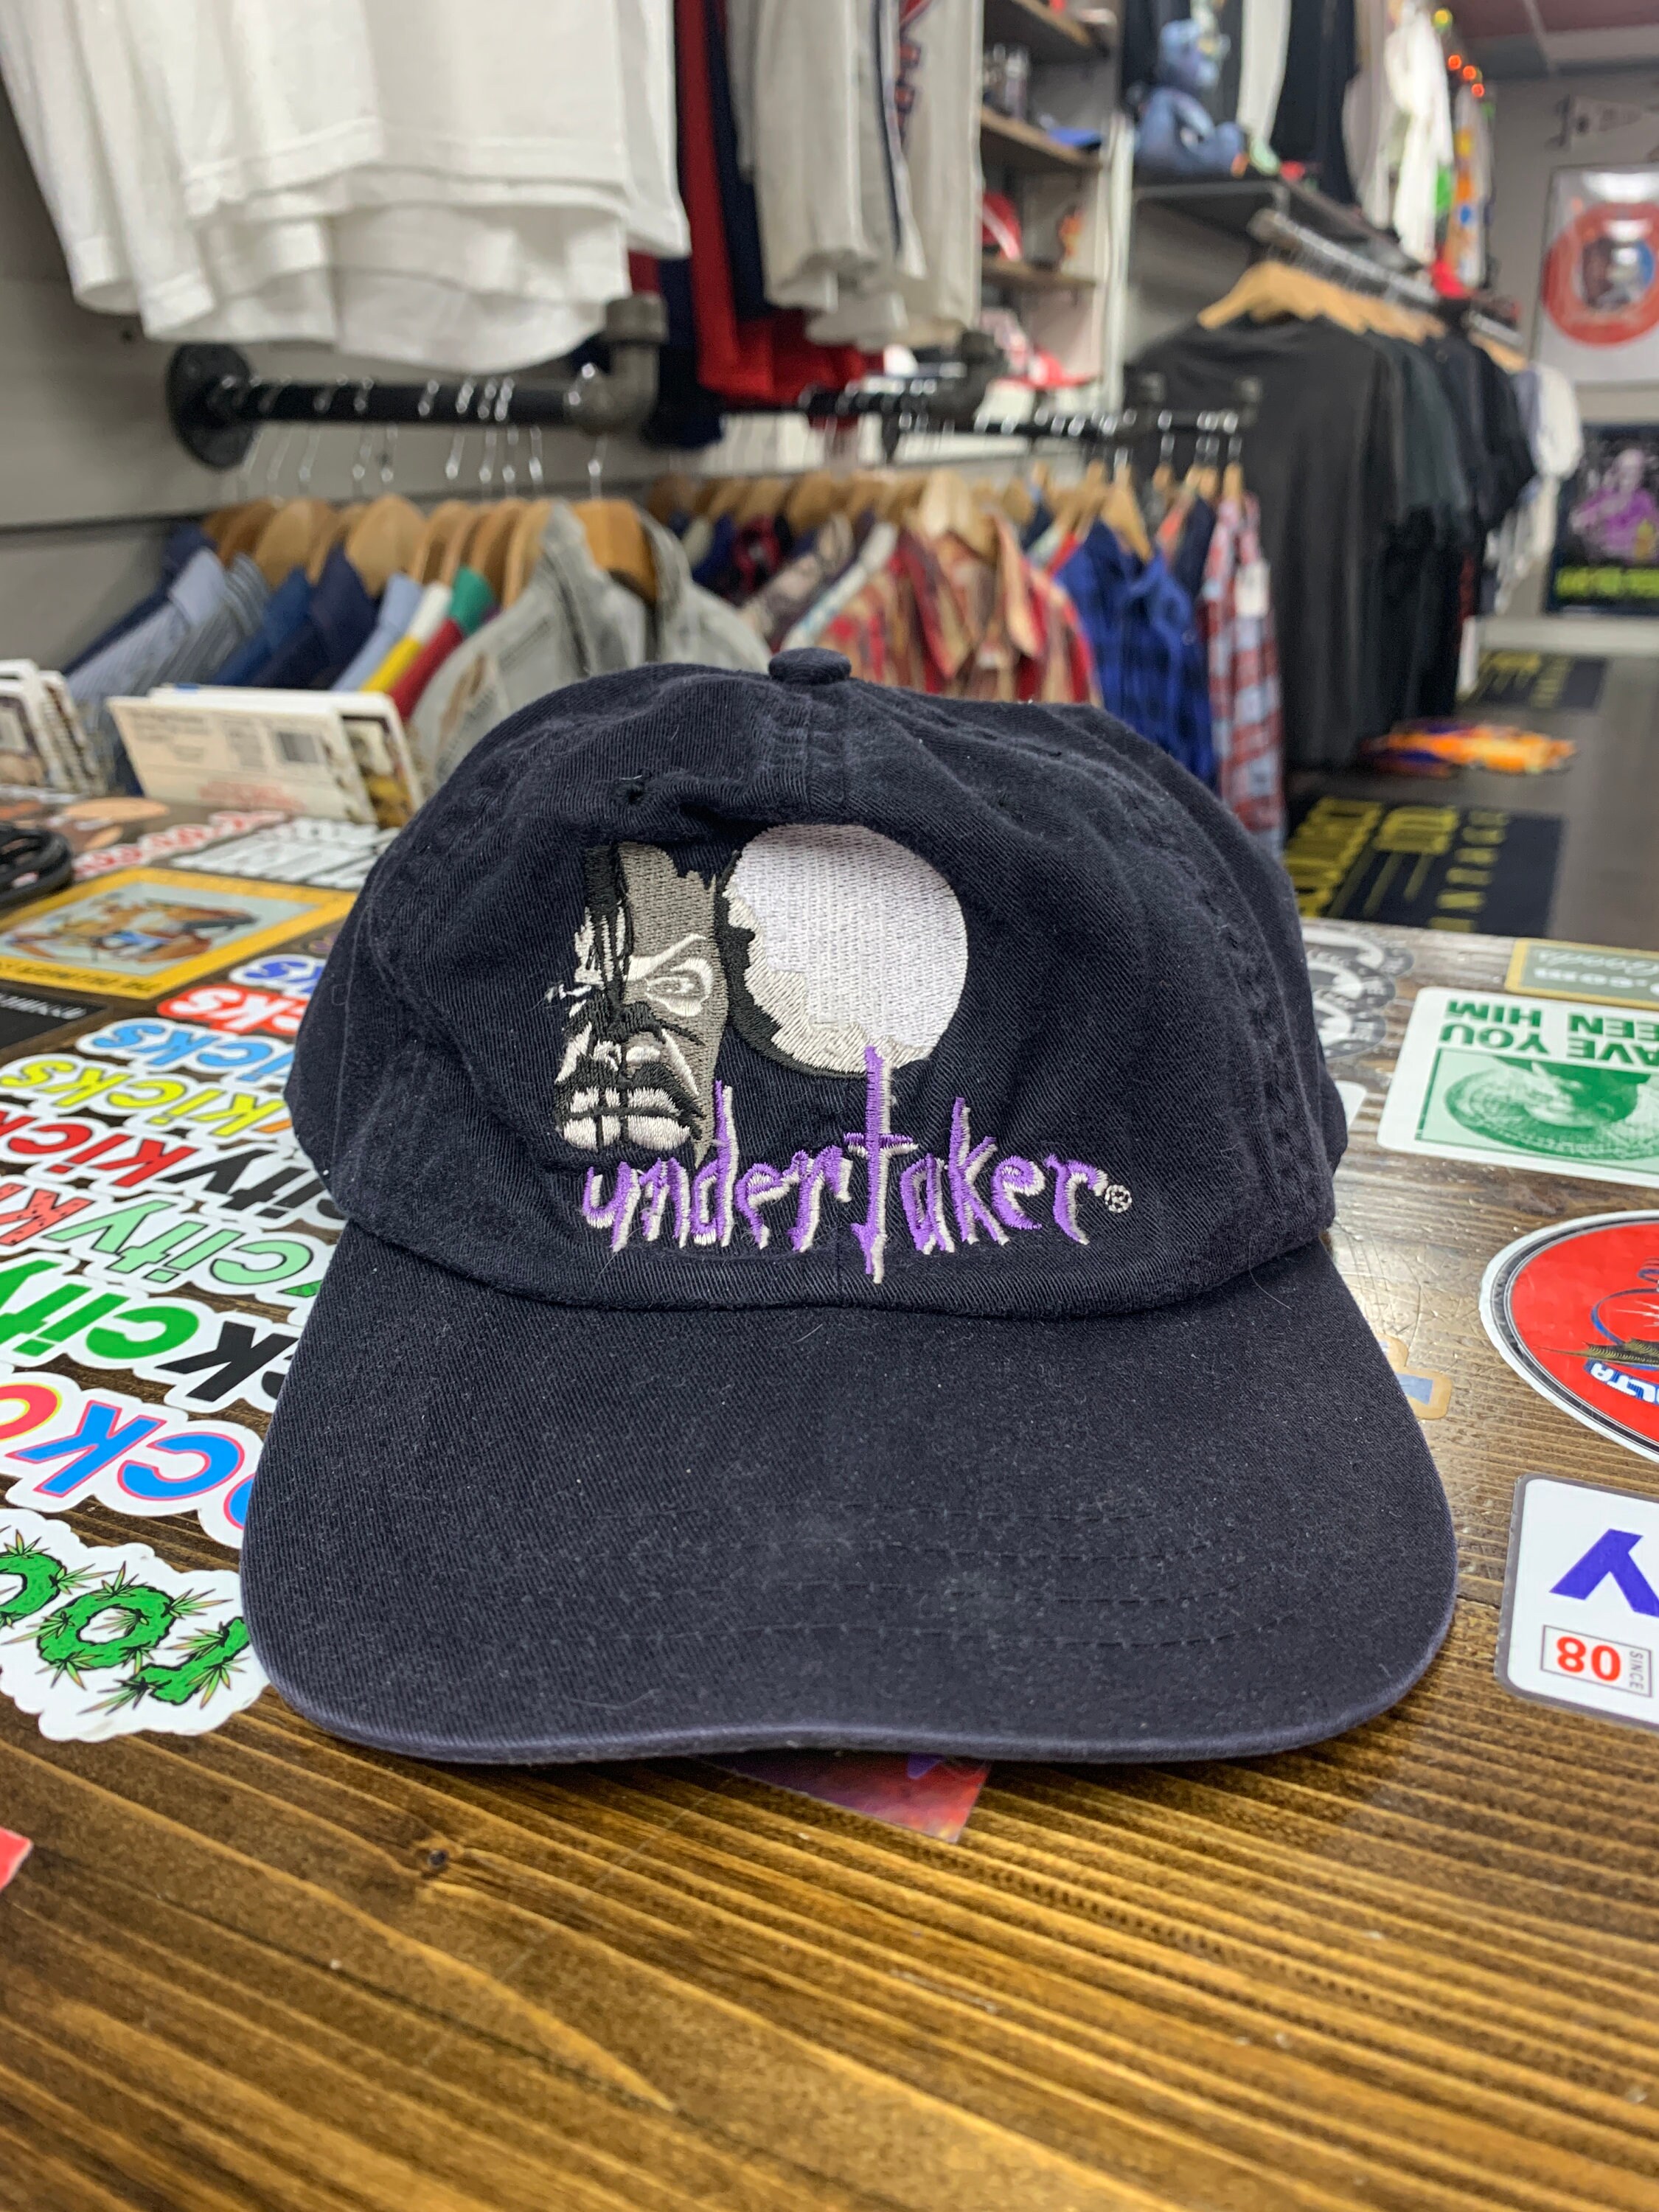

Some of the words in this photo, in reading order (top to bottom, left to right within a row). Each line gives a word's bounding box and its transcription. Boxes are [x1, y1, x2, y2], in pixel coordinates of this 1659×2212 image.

[1445, 999, 1542, 1028] HIM
[92, 1023, 296, 1082] icks
[1440, 1023, 1550, 1054] YOU
[1590, 1362, 1659, 1404] LTA
[1556, 1635, 1621, 1682] 08
[1629, 1649, 1645, 1691] SINCE
